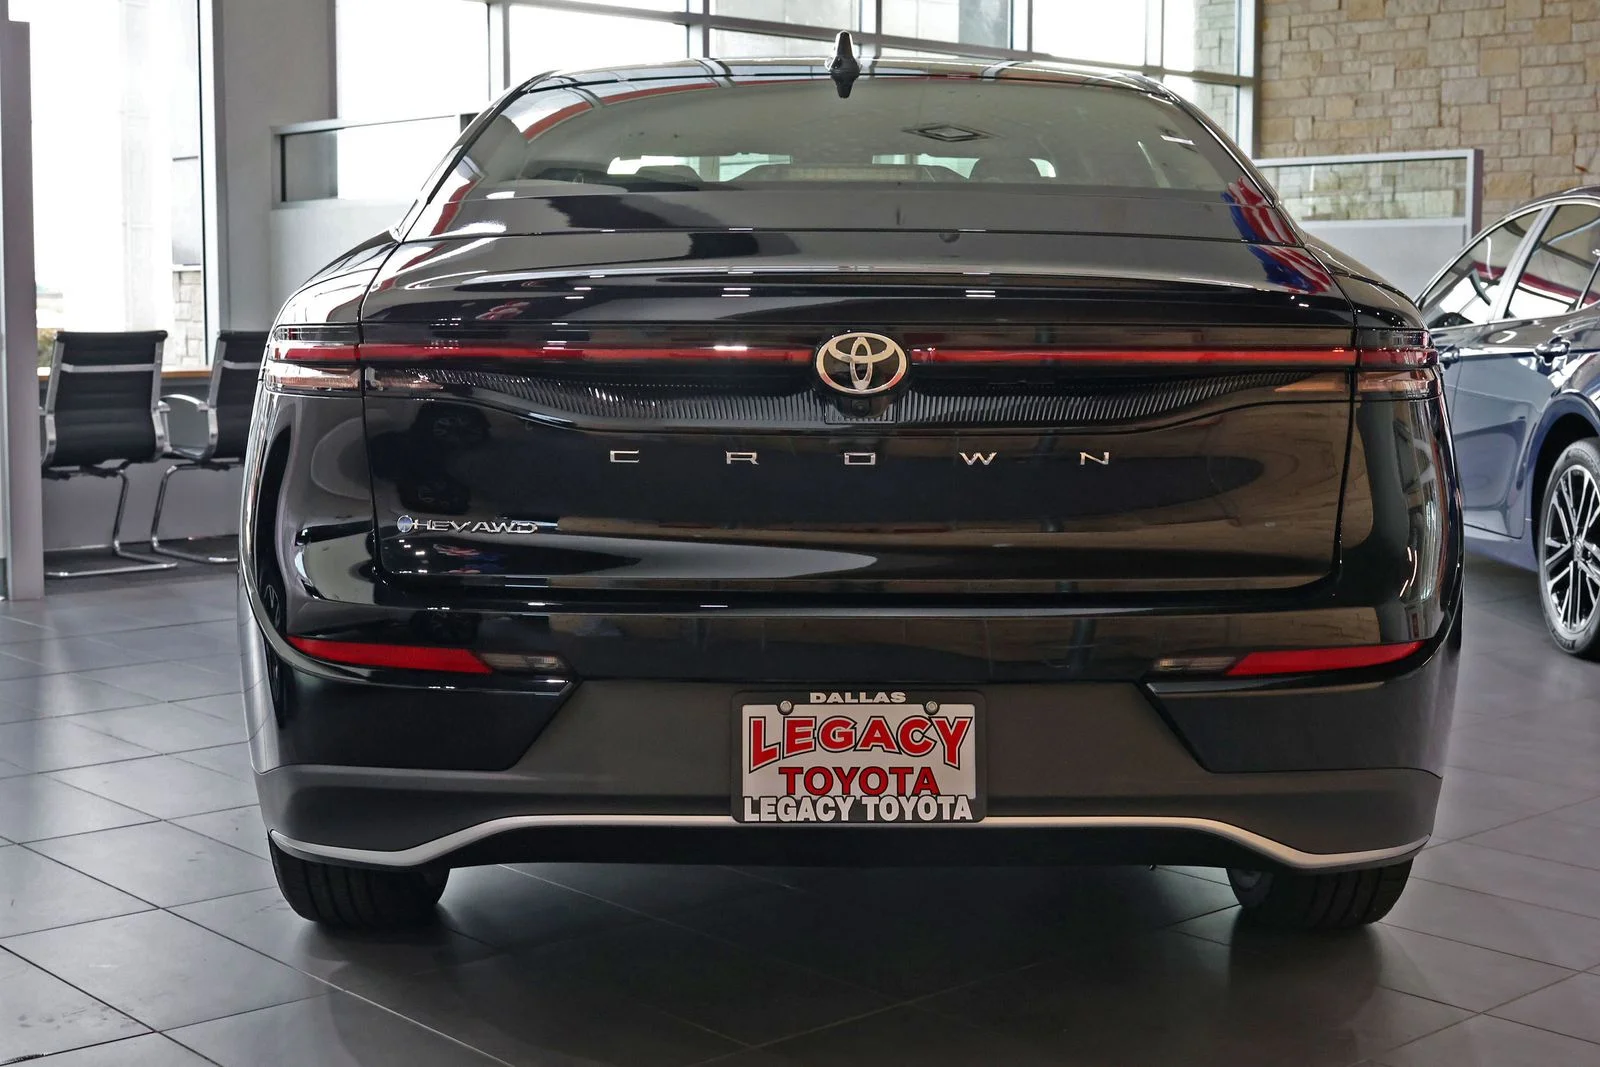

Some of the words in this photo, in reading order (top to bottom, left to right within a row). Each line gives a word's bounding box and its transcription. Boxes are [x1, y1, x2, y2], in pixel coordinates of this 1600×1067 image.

[609, 449, 1110, 466] CROWN
[809, 691, 907, 704] DALLAS
[749, 715, 974, 774] LEGACY
[778, 766, 941, 796] TOYOTA
[743, 796, 855, 822] LEGACY
[861, 795, 974, 821] TOYOTA
